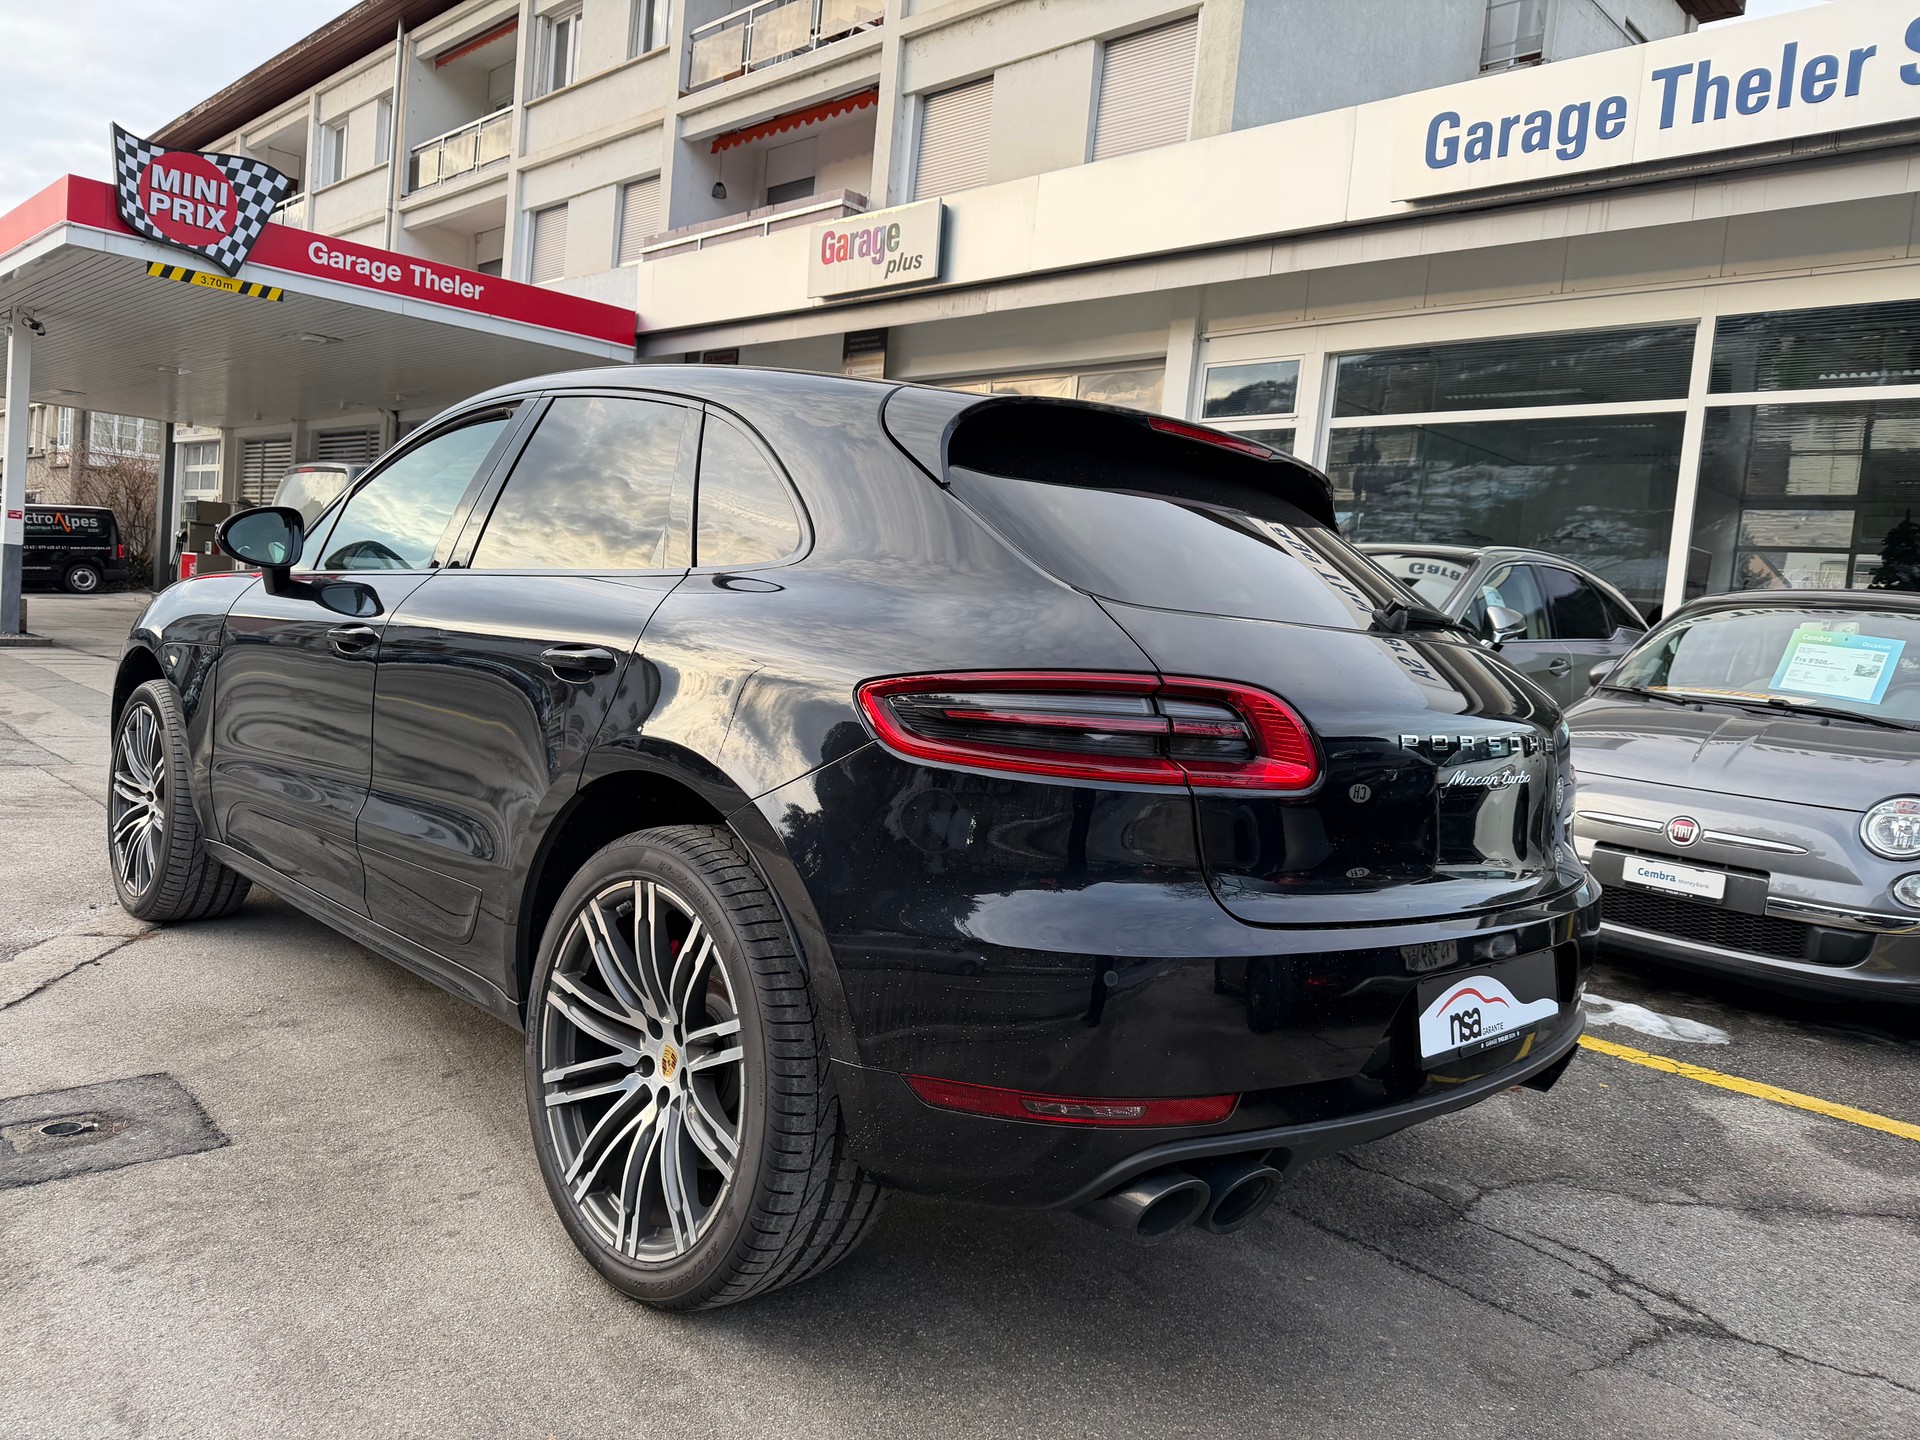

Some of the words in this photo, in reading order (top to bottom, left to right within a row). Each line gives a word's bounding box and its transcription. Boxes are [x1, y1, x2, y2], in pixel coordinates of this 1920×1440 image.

[1424, 95, 1627, 169] Garage
[1652, 41, 1877, 130] Theler
[151, 164, 228, 206] MINI
[150, 191, 227, 233] PRIX
[821, 222, 901, 265] Garage
[308, 241, 402, 283] Garage
[409, 264, 485, 300] Theler
[884, 252, 923, 280] plus
[1802, 633, 1832, 643] Cembra
[1862, 641, 1892, 650] Occasion
[1398, 734, 1554, 751] PORSCHE
[1446, 770, 1499, 787] Macan
[1673, 824, 1694, 839] FIAT
[1638, 867, 1676, 882] Cembra
[1450, 1007, 1482, 1045] nsa
[1483, 1021, 1504, 1036] GARANTIE
